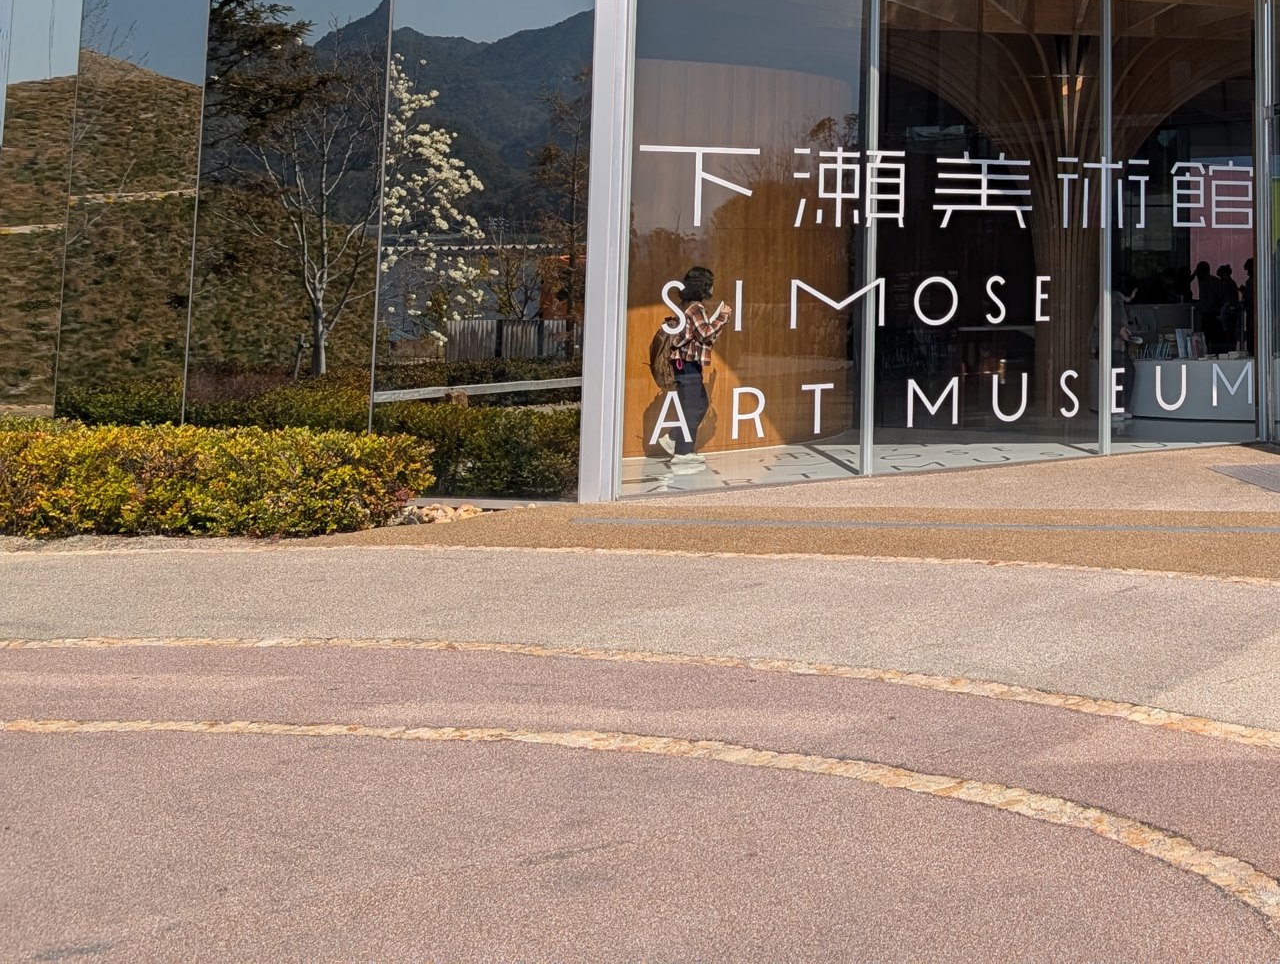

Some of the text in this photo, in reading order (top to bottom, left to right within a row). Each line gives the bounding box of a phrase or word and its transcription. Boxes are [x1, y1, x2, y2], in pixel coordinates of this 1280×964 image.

[639, 144, 1254, 229] 下瀬美術館
[660, 275, 1051, 335] SIMOSE
[649, 382, 834, 445] ART
[906, 361, 1253, 428] MUSEUM
